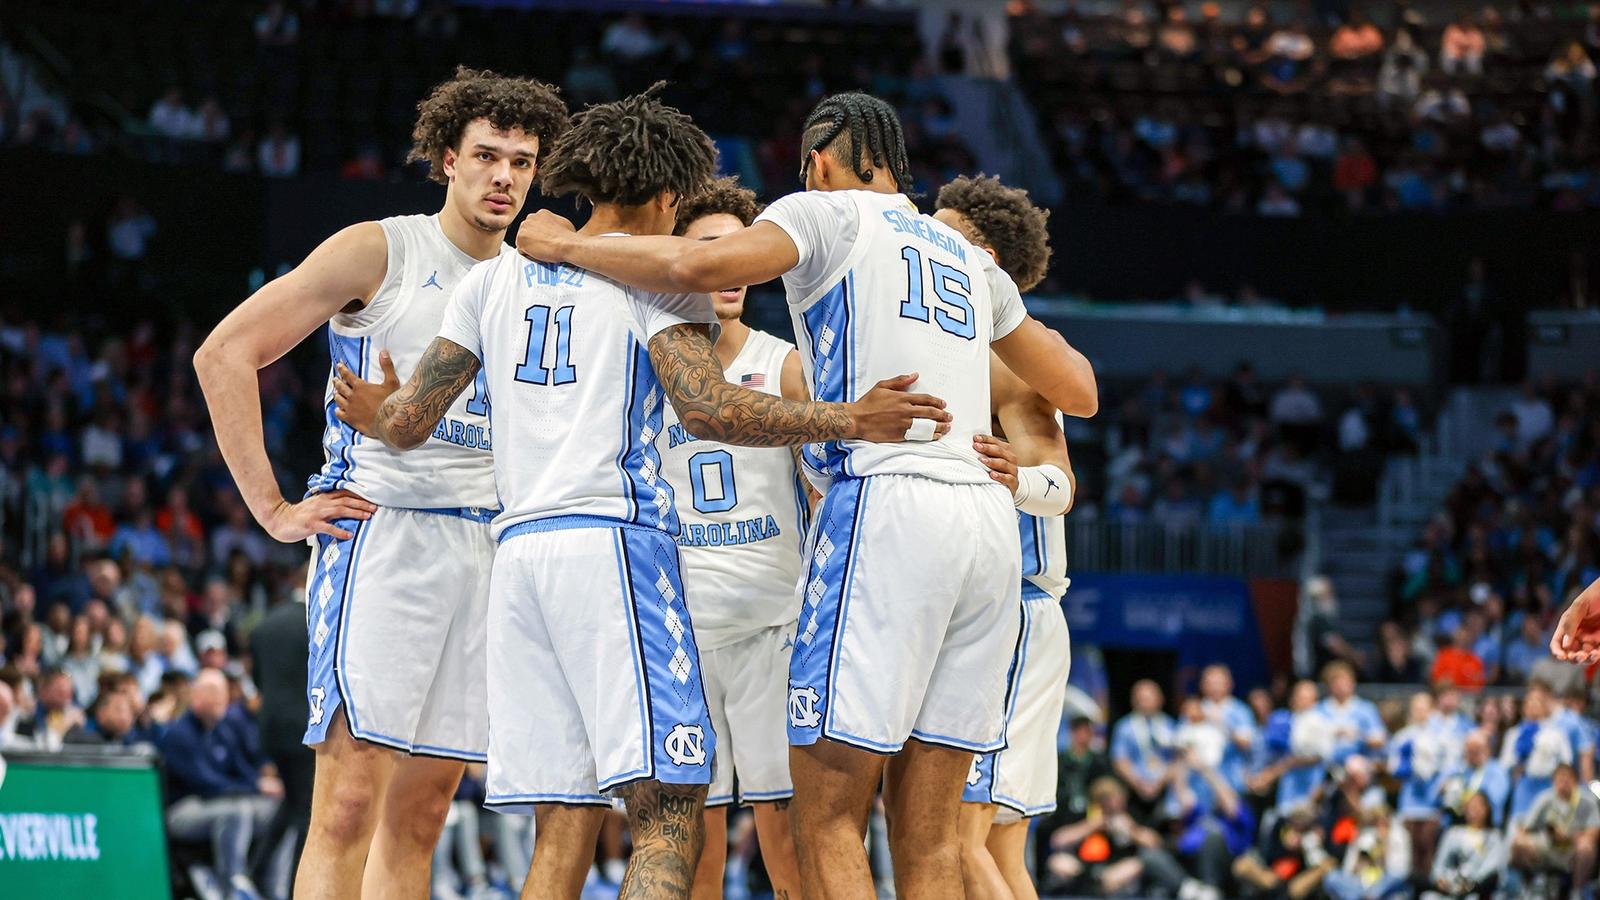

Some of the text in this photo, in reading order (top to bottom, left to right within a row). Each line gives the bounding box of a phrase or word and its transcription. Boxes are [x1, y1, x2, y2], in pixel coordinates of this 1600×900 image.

[883, 208, 967, 265] STEVENSON
[899, 245, 976, 341] 15
[513, 304, 577, 386] 11
[688, 449, 738, 514] 0
[677, 514, 780, 547] AROLINA
[659, 791, 697, 818] ROOT
[0, 812, 100, 860] VIERVILLE
